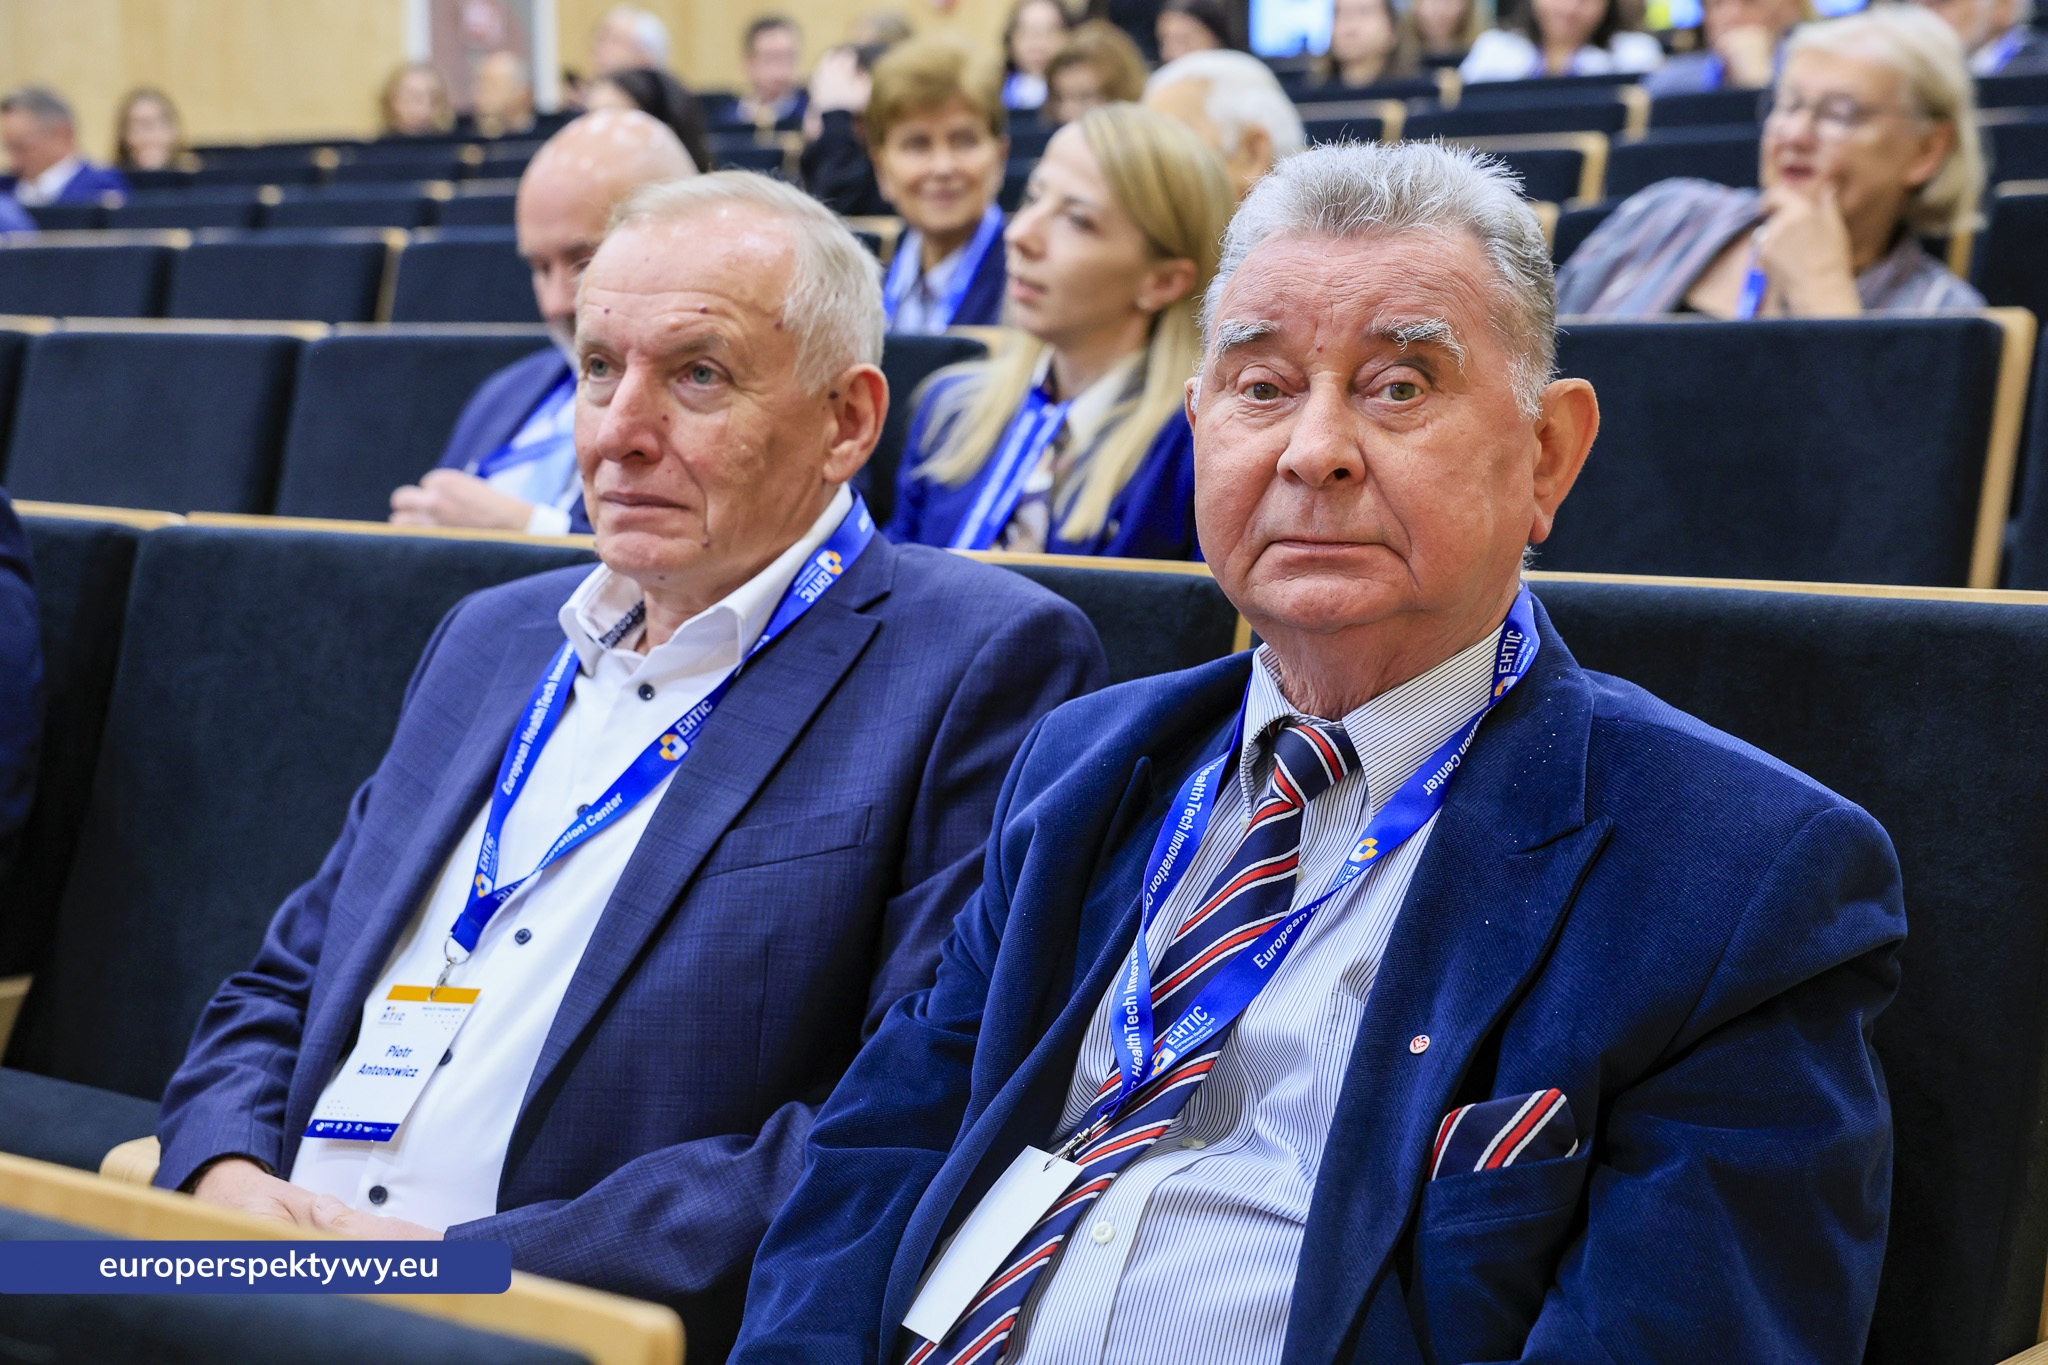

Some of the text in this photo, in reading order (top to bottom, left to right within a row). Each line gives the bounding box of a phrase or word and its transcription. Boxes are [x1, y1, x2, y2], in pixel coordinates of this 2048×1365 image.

[800, 570, 834, 604] EHTIC
[1498, 630, 1523, 674] EHTIC
[674, 699, 713, 737] EHTIC
[501, 741, 531, 796] European
[1422, 754, 1461, 796] Center
[585, 792, 623, 827] Center
[478, 831, 494, 873] EHTIC
[1149, 829, 1190, 896] Innovation
[1253, 912, 1307, 970] European
[1122, 996, 1143, 1077] HealthTech
[1166, 1006, 1208, 1046] EHTIC
[357, 1063, 419, 1078] Antonowicz
[385, 1045, 413, 1058] Piotr
